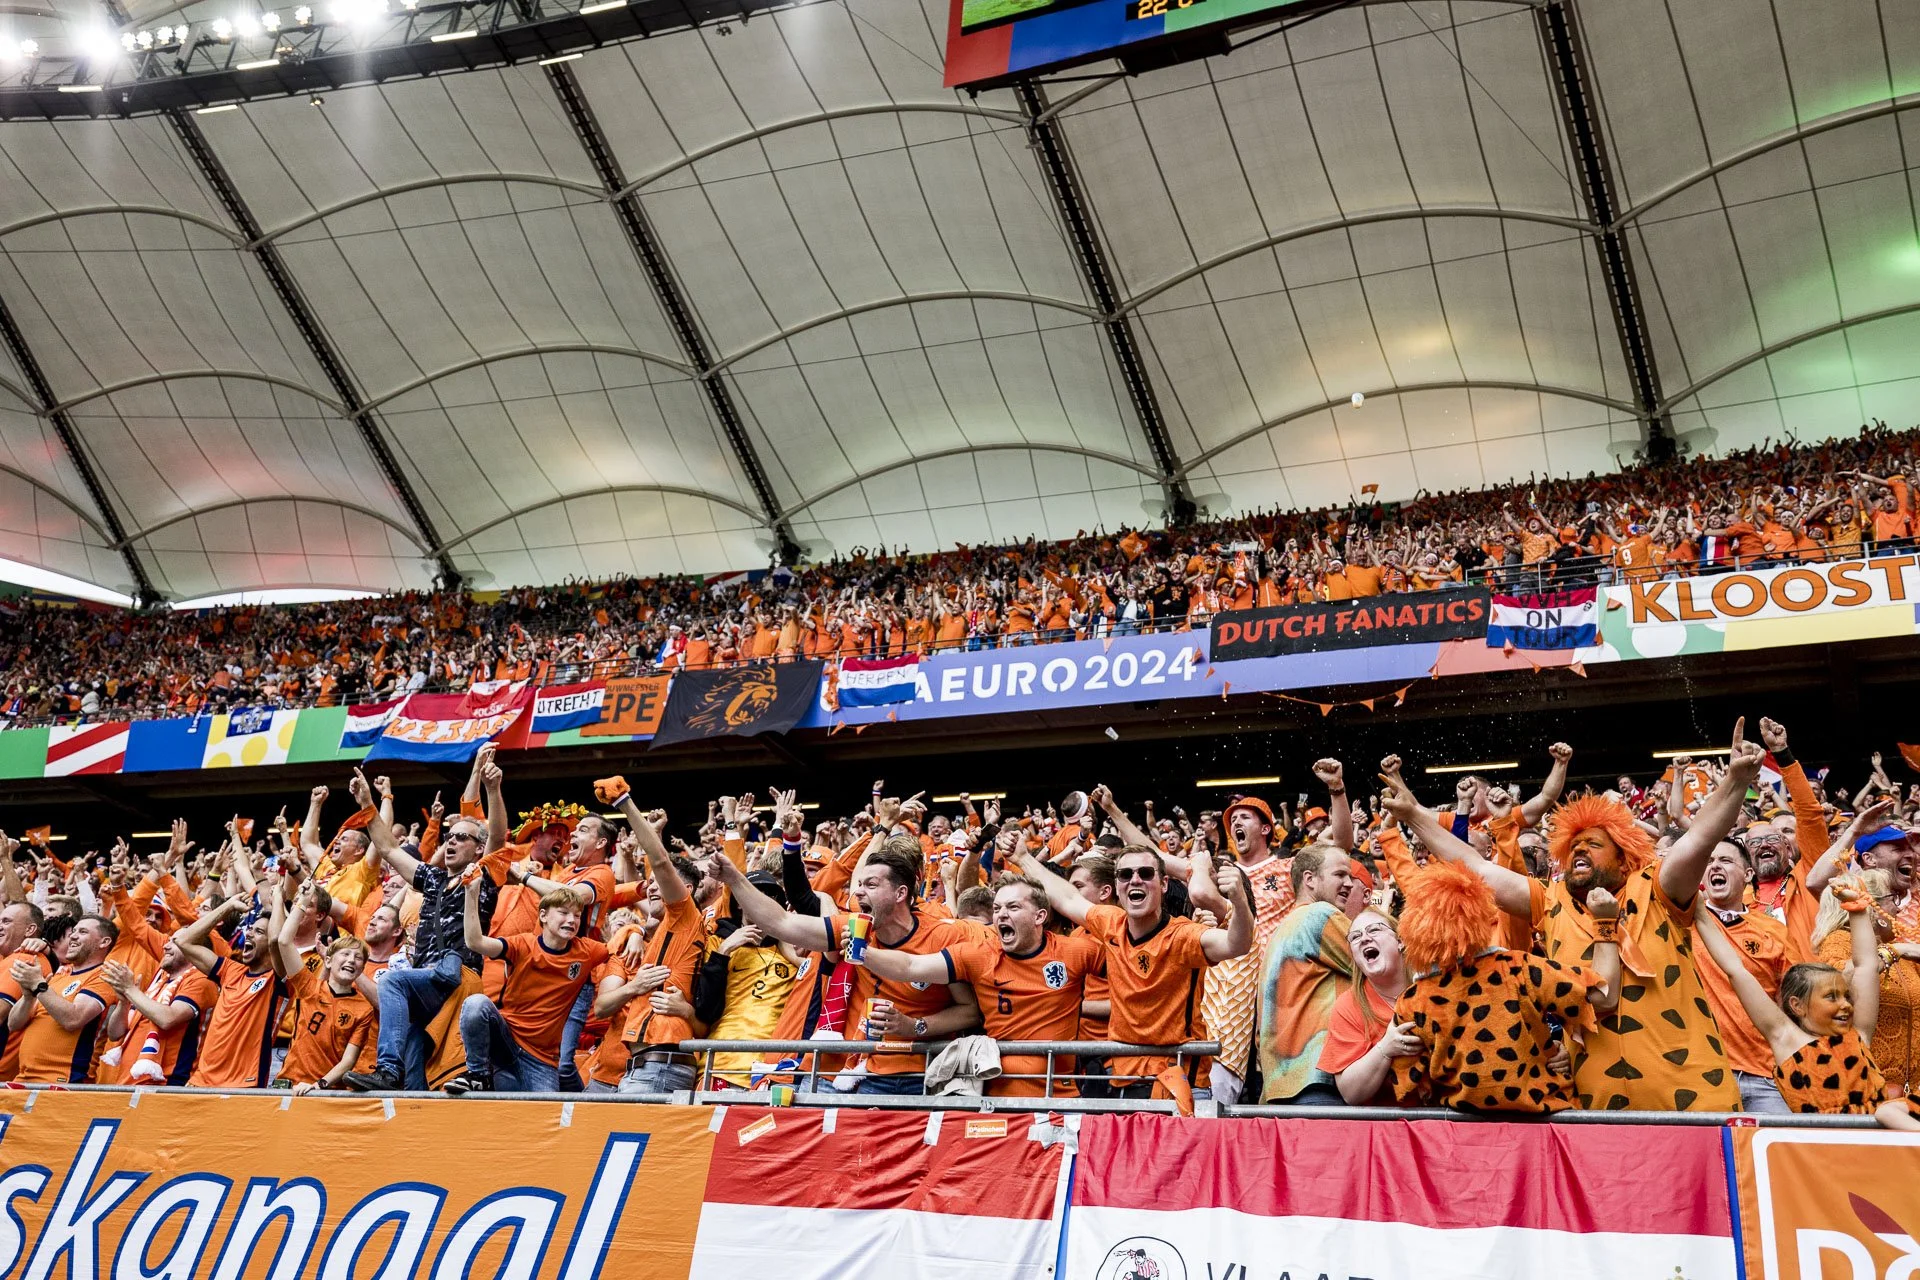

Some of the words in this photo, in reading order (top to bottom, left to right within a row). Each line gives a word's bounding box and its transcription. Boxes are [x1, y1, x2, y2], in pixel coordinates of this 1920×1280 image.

[1138, 0, 1169, 19] 22
[1622, 549, 1633, 566] 9
[1630, 556, 1920, 624] KLOOST
[1217, 613, 1327, 647] DUTCH
[1334, 598, 1484, 633] FANATICS
[1526, 608, 1562, 629] ON
[1510, 626, 1578, 648] TOUR
[537, 691, 600, 714] UTRECHT
[998, 990, 1013, 1015] 6
[308, 1011, 326, 1035] 8
[0, 1114, 650, 1280] skanaal
